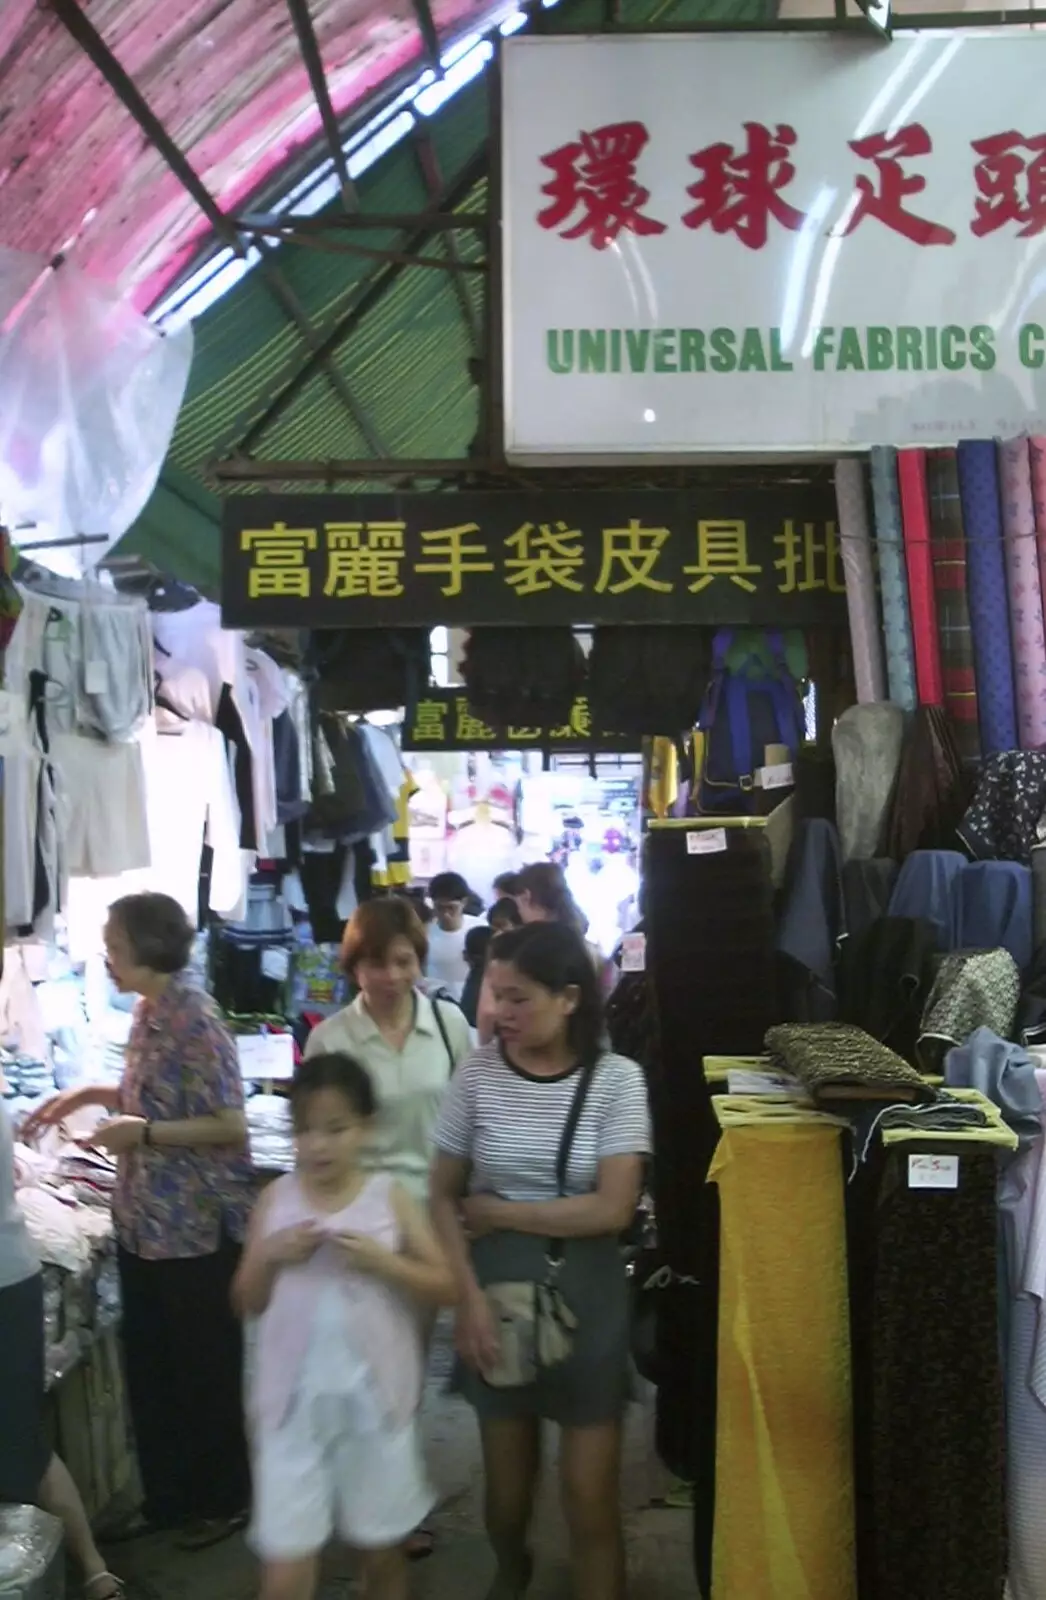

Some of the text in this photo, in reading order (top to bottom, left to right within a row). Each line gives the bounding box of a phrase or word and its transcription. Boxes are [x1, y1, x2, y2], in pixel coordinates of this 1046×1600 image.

[547, 328, 792, 373] UNIVERSAL
[814, 327, 996, 371] FABRICS
[239, 519, 844, 599] 富麗手袋皮具批
